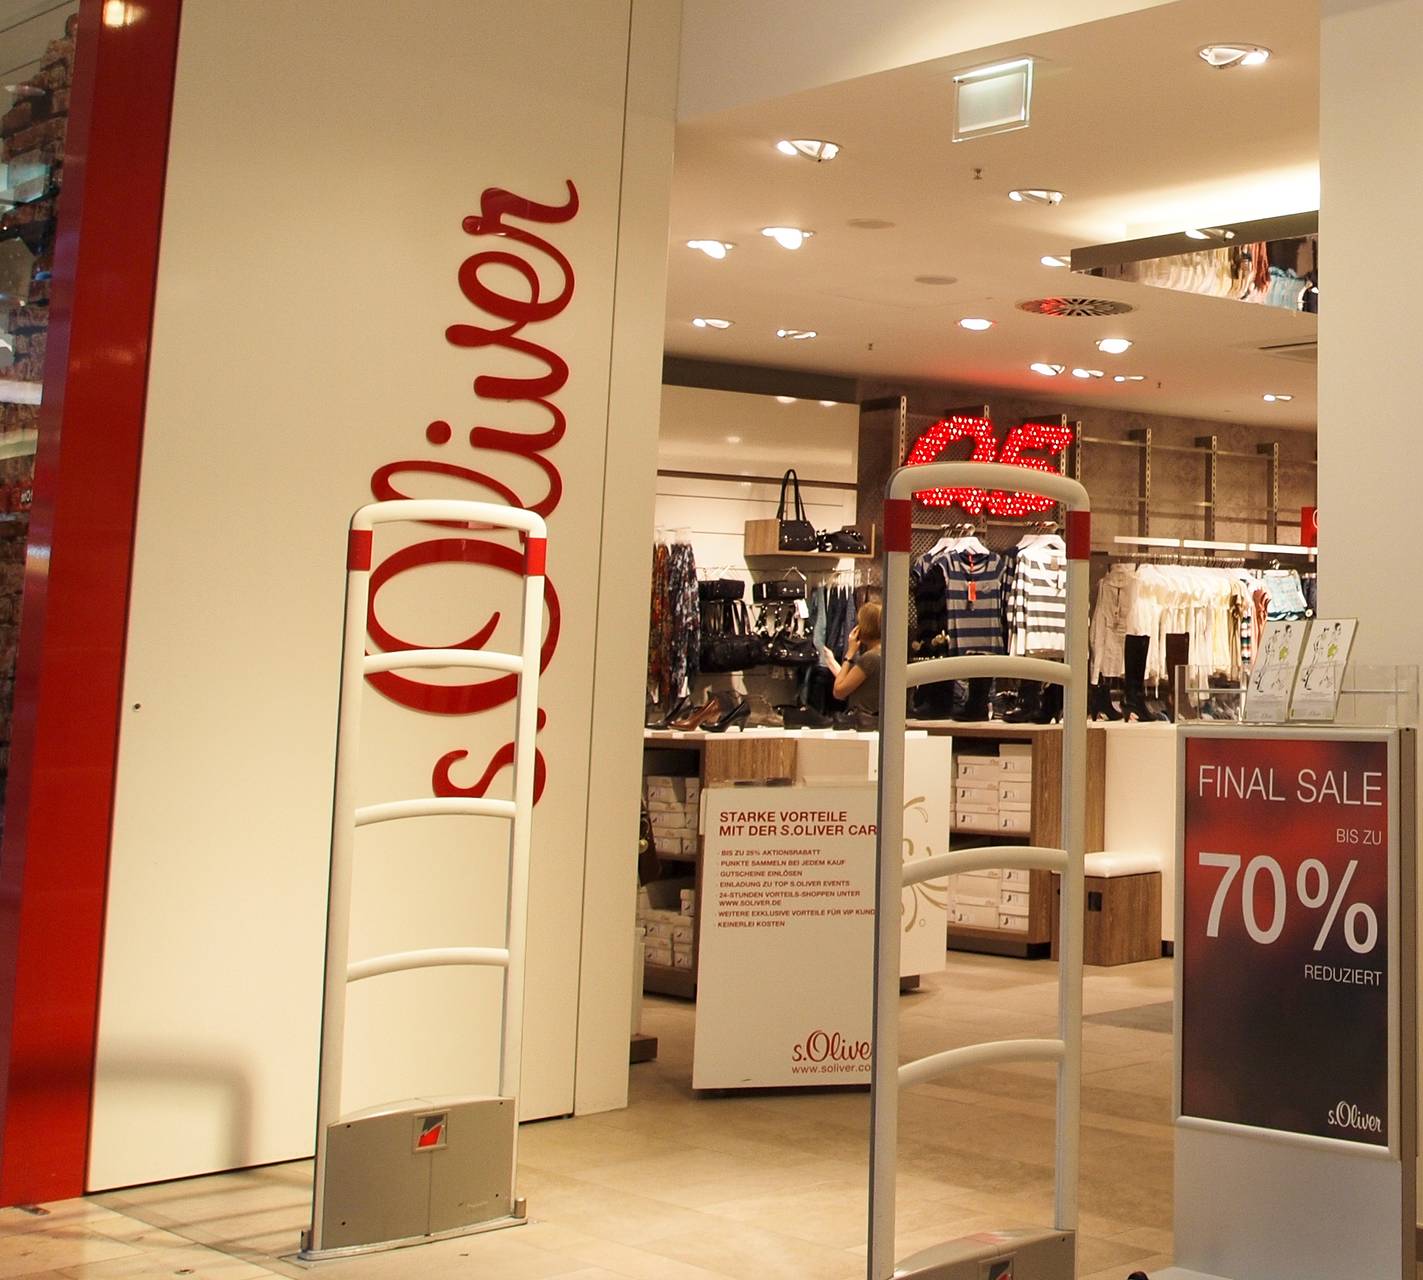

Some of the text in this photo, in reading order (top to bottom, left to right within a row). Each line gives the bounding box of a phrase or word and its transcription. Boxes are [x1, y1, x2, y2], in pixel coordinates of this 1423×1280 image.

[363, 178, 579, 808] s.Oliver
[1199, 765, 1383, 806] FINAL SALE
[719, 811, 848, 823] STARKE VORTEILE
[719, 825, 877, 836] MIT DER S.OLIVER CAR
[1336, 828, 1382, 845] BIS ZU
[767, 869, 803, 877] EINLÖSEN
[791, 909, 826, 917] VORTEILE
[827, 908, 841, 916] FÜR
[1199, 852, 1378, 954] 70%
[1304, 964, 1383, 987] REDUZIERT
[792, 1029, 872, 1062] s.Olive
[791, 1063, 871, 1074] www.soliver.co
[1328, 1101, 1382, 1132] s.Oliver
